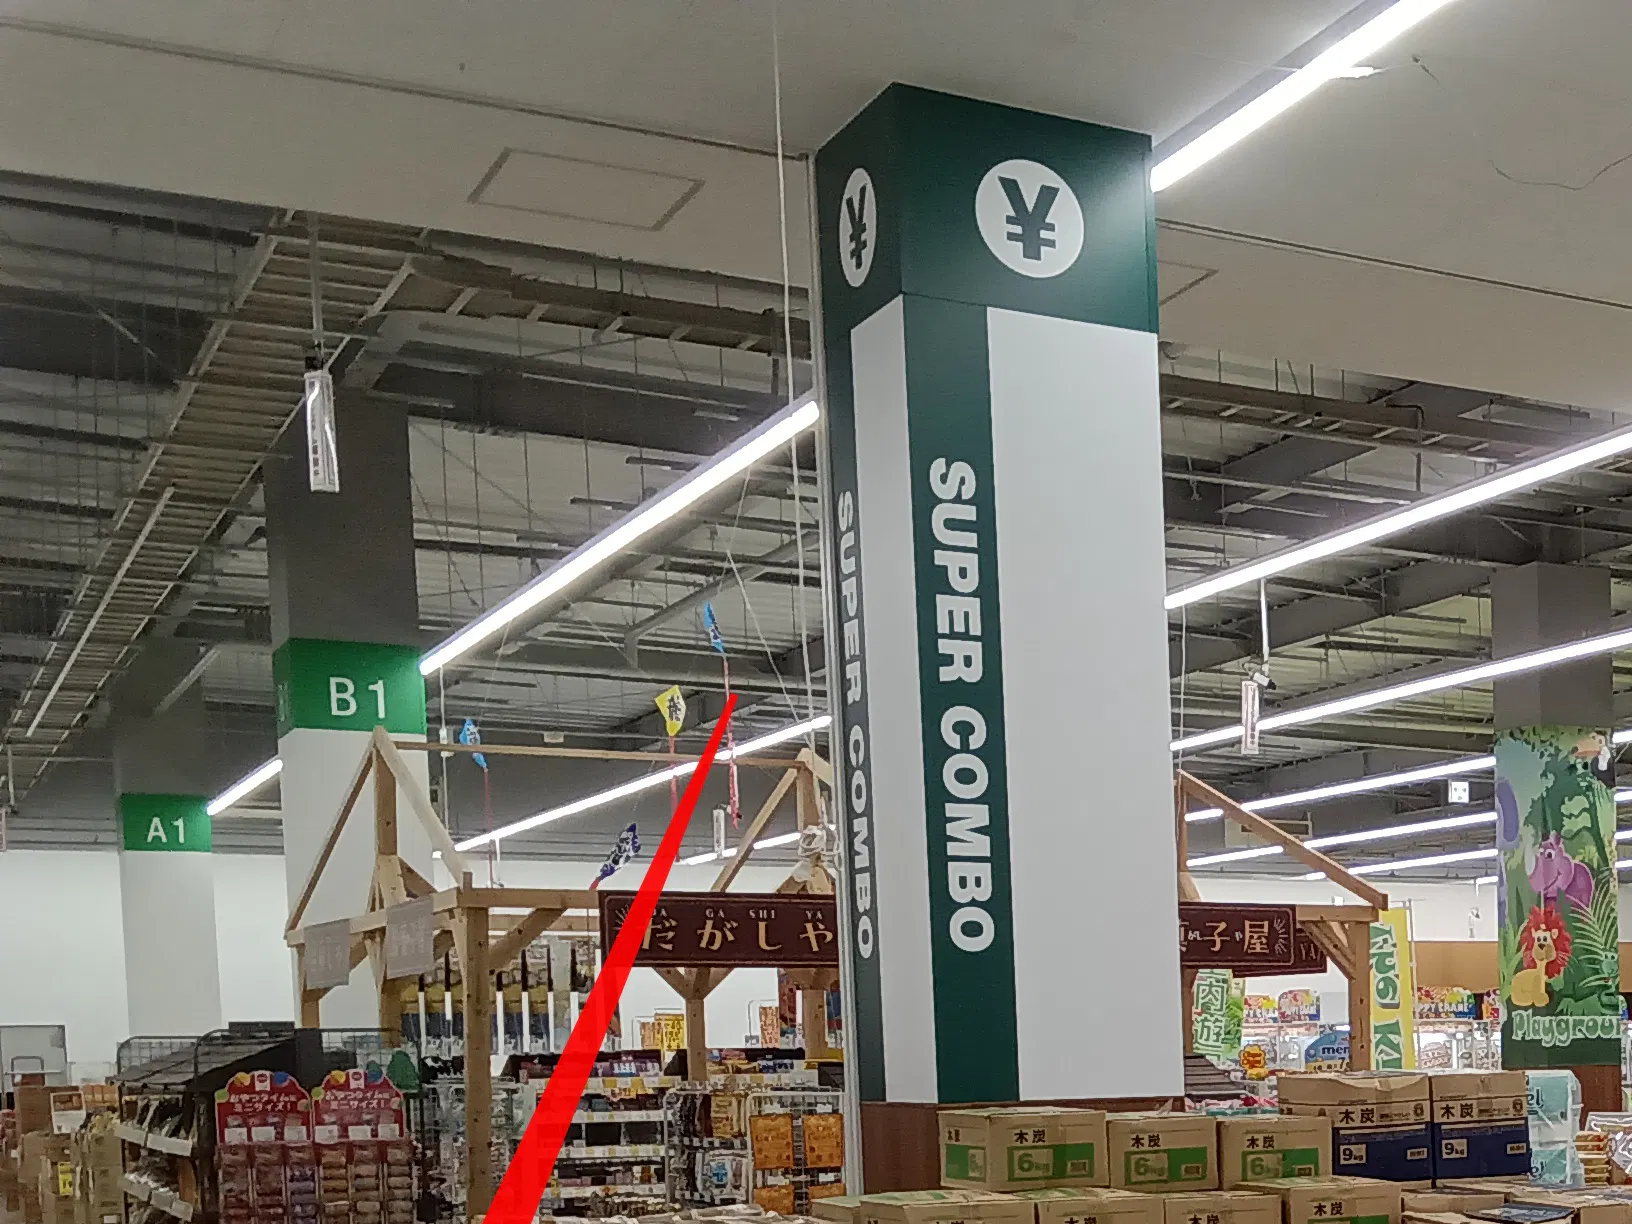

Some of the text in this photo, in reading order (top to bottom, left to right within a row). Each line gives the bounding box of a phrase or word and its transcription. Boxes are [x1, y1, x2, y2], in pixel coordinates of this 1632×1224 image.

[328, 676, 387, 720] B1
[929, 457, 996, 954] SUPER COMBO
[837, 490, 874, 959] SUPER COMBO
[146, 816, 187, 845] A1
[641, 918, 834, 952] だがしや
[1440, 1103, 1475, 1120] 木炭
[1131, 1133, 1161, 1148] 木炭
[1017, 1153, 1052, 1175] 6kg
[1134, 1156, 1167, 1177] 6kg
[1342, 1147, 1364, 1162] 9kg
